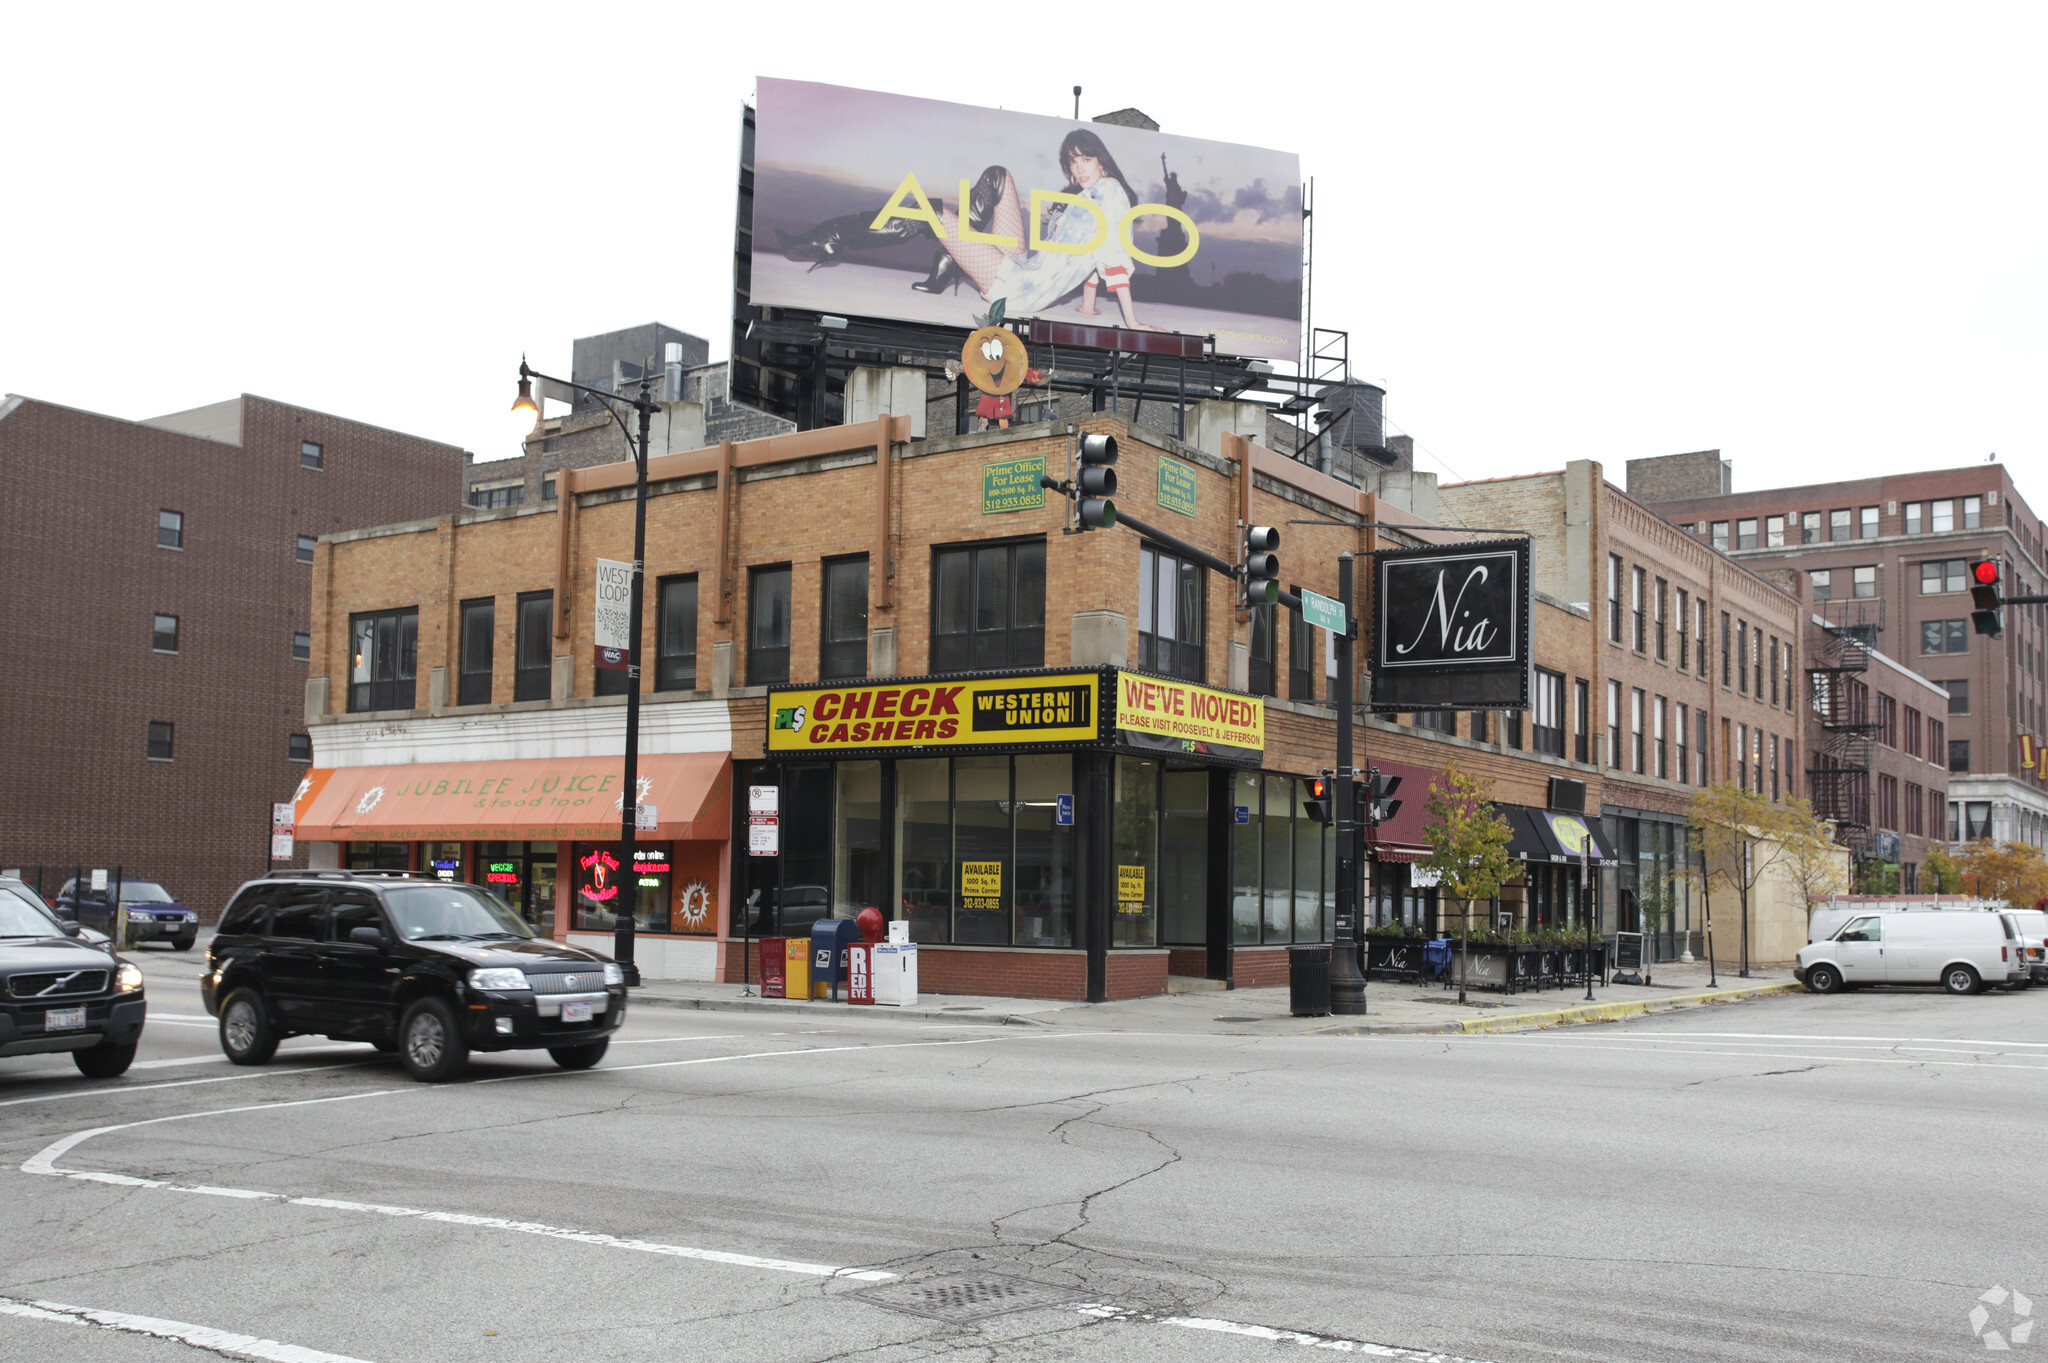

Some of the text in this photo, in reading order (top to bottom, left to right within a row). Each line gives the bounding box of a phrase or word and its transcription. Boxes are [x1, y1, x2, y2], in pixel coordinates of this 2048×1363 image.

[868, 170, 1200, 268] ALDO
[1198, 328, 1289, 345] ALDOSHOES.COM
[985, 462, 1042, 477] Prime Office
[1160, 459, 1195, 482] Prime Office
[992, 474, 1035, 487] For Lease
[1165, 470, 1191, 490] For Lease
[988, 484, 1036, 497] 800-2800 Sq. Ft.
[985, 494, 1042, 510] 312.933.0855
[1160, 491, 1194, 513] 312.933.0855
[599, 566, 630, 586] WEST
[599, 584, 629, 603] LOOP
[1311, 597, 1337, 617] RANDOLPH
[1396, 565, 1498, 654] Nia
[812, 686, 966, 721] CHECK
[977, 691, 1070, 711] WESTERN
[1125, 679, 1257, 729] WE'VE MOVED!
[1005, 707, 1070, 726] UNION
[809, 718, 959, 744] CASHERS
[1120, 713, 1261, 745] PLEASE VISIT ROOSEVELT & JEFFERSON
[396, 774, 617, 797] JUBILEE JUICE
[473, 796, 594, 808] & food too!
[490, 863, 514, 872] VEGGIE
[964, 864, 1000, 876] AVAILABLE
[1120, 868, 1144, 879] AVAILABLE
[487, 873, 518, 884] SPECIALS
[980, 878, 989, 886] Sq.
[964, 898, 1000, 910] 312-933-0855
[1379, 948, 1408, 969] Nia
[1466, 954, 1492, 976] Nia
[851, 974, 867, 988] ED
[851, 988, 867, 998] EYE
